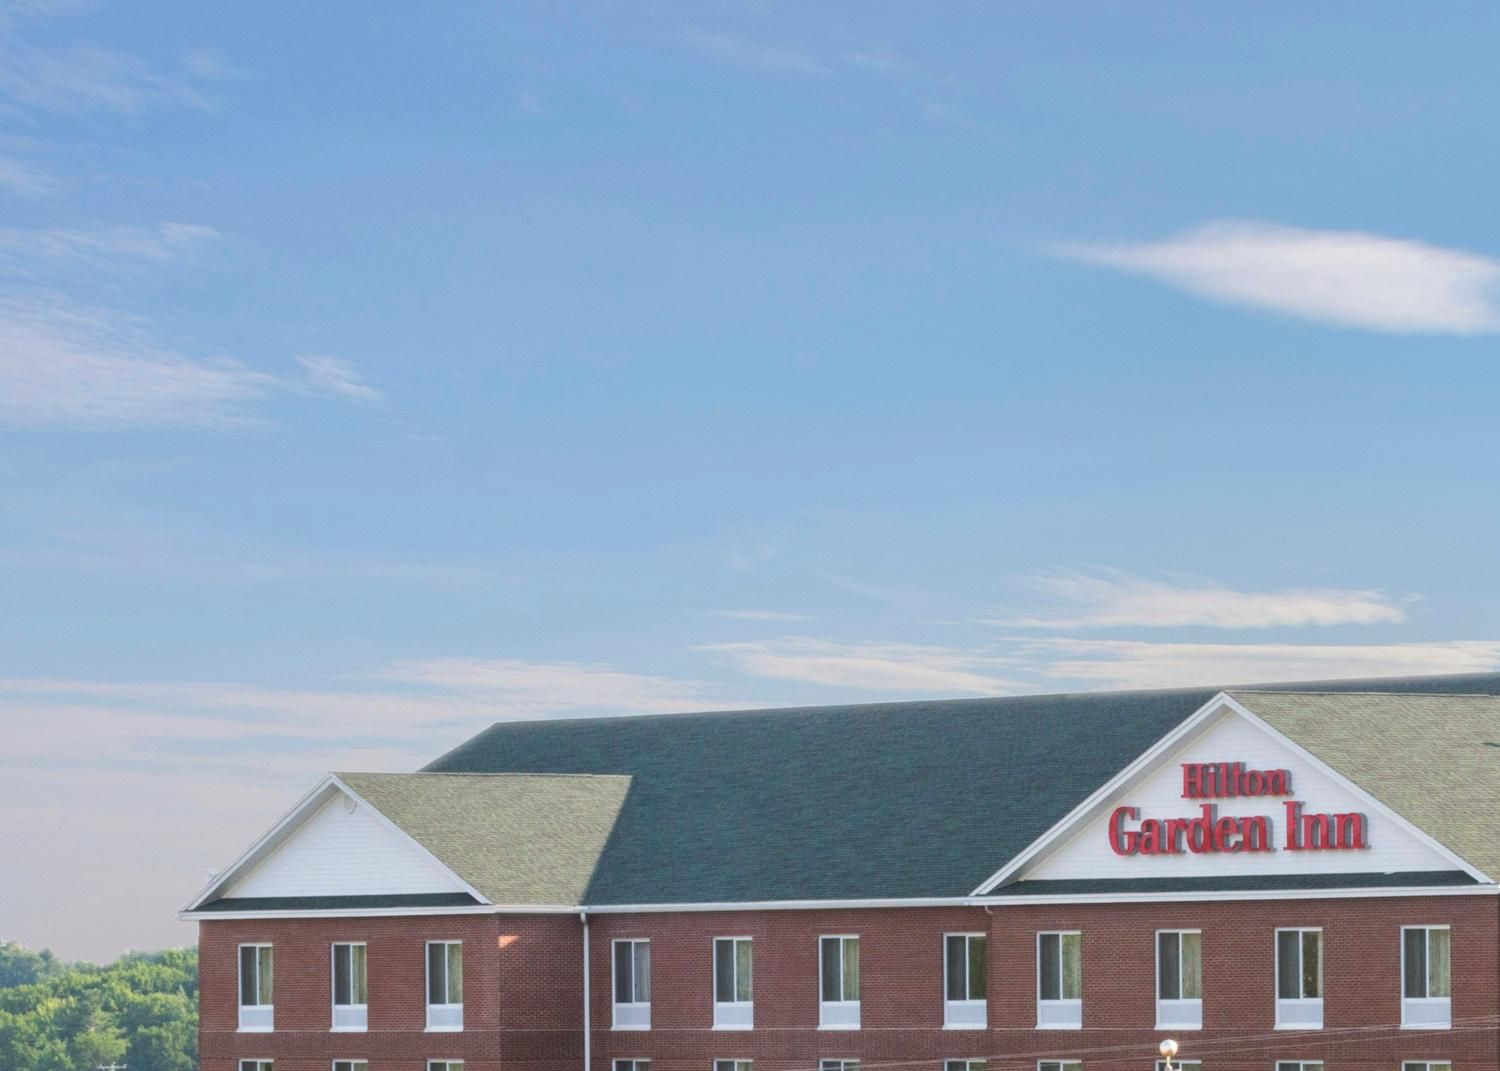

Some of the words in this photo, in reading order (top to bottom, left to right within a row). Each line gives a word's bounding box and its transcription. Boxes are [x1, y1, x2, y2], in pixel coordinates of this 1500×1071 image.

[1181, 762, 1291, 798] Hilton
[1108, 803, 1272, 857] Garden
[1282, 800, 1369, 850] Inn
